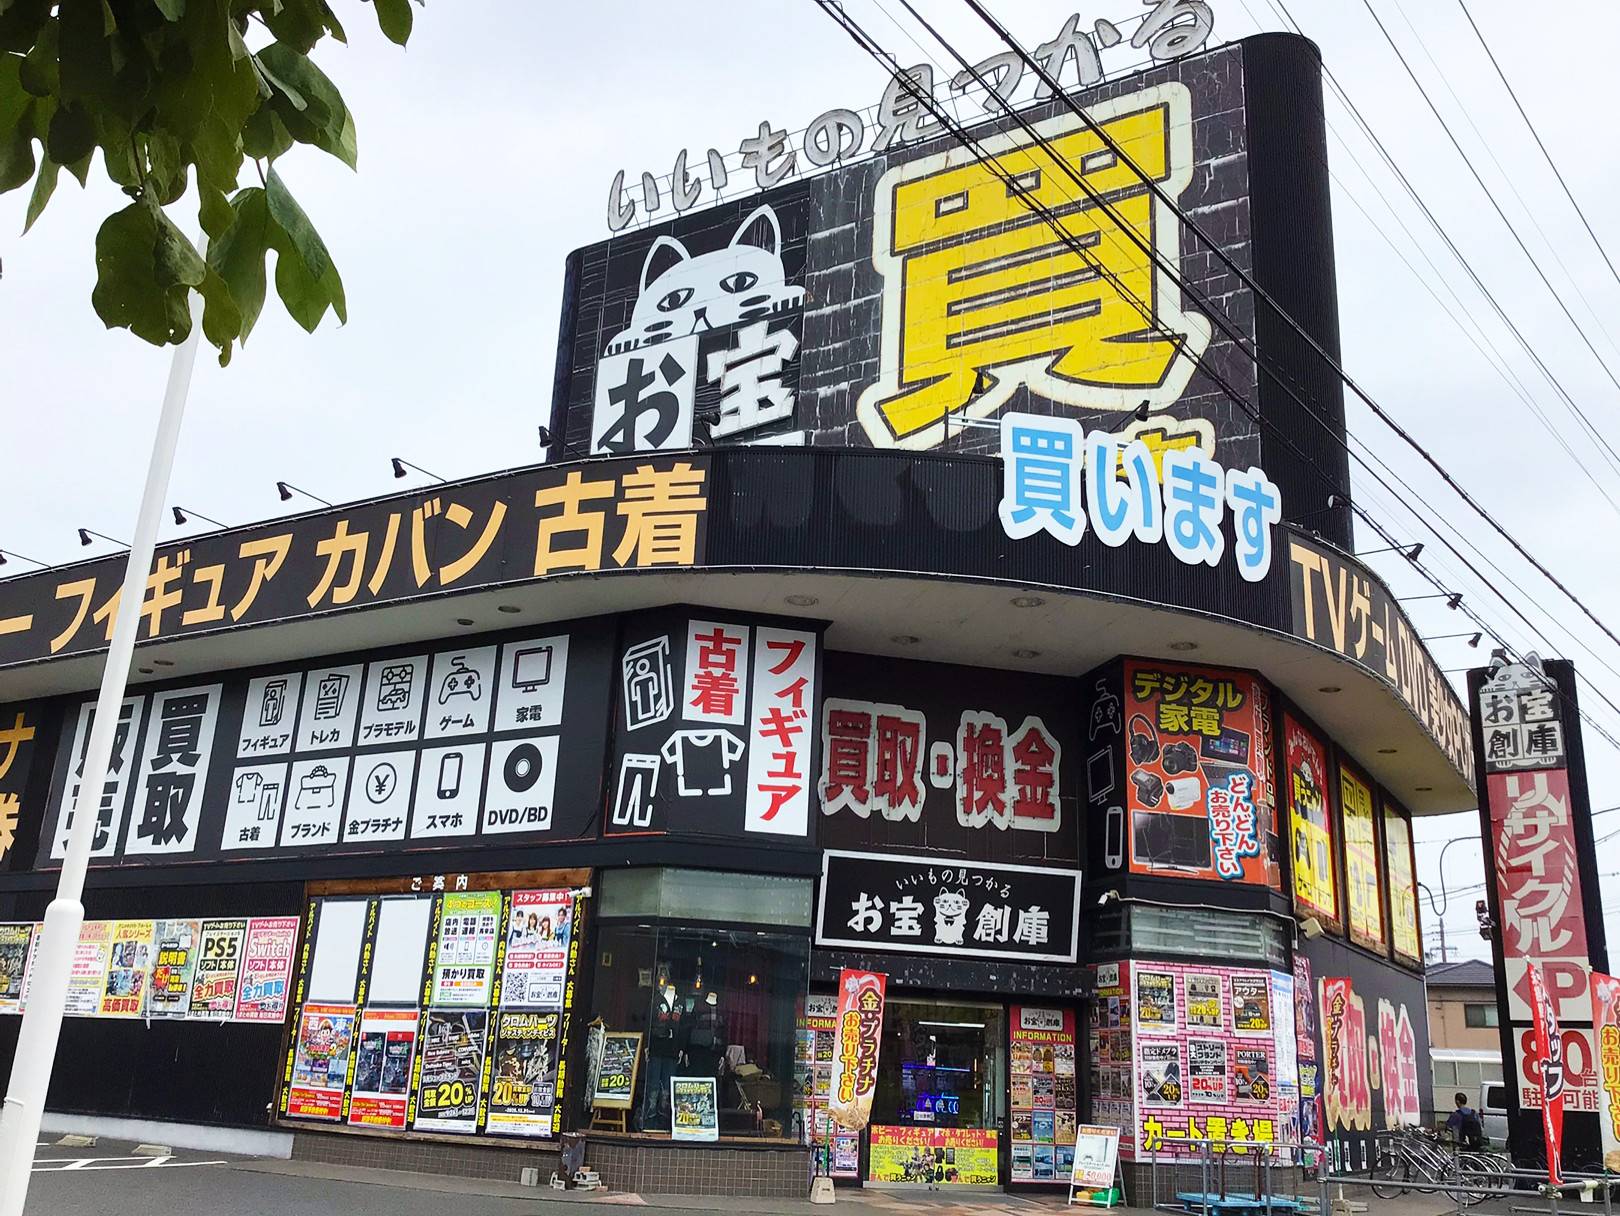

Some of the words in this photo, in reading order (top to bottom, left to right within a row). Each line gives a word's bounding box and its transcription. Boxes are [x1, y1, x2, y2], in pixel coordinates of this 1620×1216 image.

[606, 0, 1215, 232] いいもの見つかる
[870, 95, 1198, 480] 買
[597, 320, 798, 452] お宝
[1005, 420, 1280, 575] 買います
[533, 463, 708, 576] 古着
[306, 497, 508, 608] カバン
[50, 533, 293, 654] フィギュア
[690, 628, 741, 716] 古着
[1134, 673, 1243, 709] デジタル
[516, 705, 542, 723] 家電
[1484, 690, 1553, 723] お宝
[363, 720, 416, 739] プラモデル
[439, 714, 474, 731] ゲーム
[758, 640, 808, 821] フィギュア
[1159, 704, 1221, 736] 家電
[242, 734, 289, 752] フィギュア
[310, 728, 340, 745] トレカ
[1488, 725, 1559, 759] 創庫
[137, 693, 209, 846] 買取
[822, 703, 1058, 826] 買取・換金
[426, 813, 463, 830] スマホ
[488, 806, 548, 826] DVD/BD
[1229, 776, 1255, 852] どんどん
[239, 827, 260, 842] 古着
[290, 822, 331, 839] ブランド
[348, 817, 403, 836] 金プラチナ
[1210, 790, 1238, 874] お売り下さい
[1502, 775, 1573, 953] リサイクル
[411, 875, 468, 891] ご案内
[896, 868, 1011, 898] いいもの見つかる
[847, 892, 924, 937] お宝
[973, 903, 1051, 945] 創庫
[203, 937, 238, 958] PS5
[248, 938, 291, 958] Switch
[201, 961, 217, 971] ソフト
[219, 961, 236, 971] 本体
[249, 961, 266, 971] ソフト
[268, 961, 286, 971] 本体
[193, 979, 235, 1001] 全力買取
[242, 979, 285, 1002] 全力買取
[1234, 987, 1266, 996] アウター
[857, 990, 880, 1093] 金・プラチナ
[1013, 1031, 1073, 1042] INFORMATION
[839, 1012, 860, 1102] お売り下さい
[1237, 1050, 1266, 1059] PORTER
[608, 1074, 626, 1087] 20
[1601, 1024, 1620, 1142] お売り下
[438, 1082, 464, 1106] 20
[493, 1082, 512, 1106] 20
[1522, 1086, 1599, 1111] 駐可能
[935, 1128, 997, 1139] マホ・タブレット・家電
